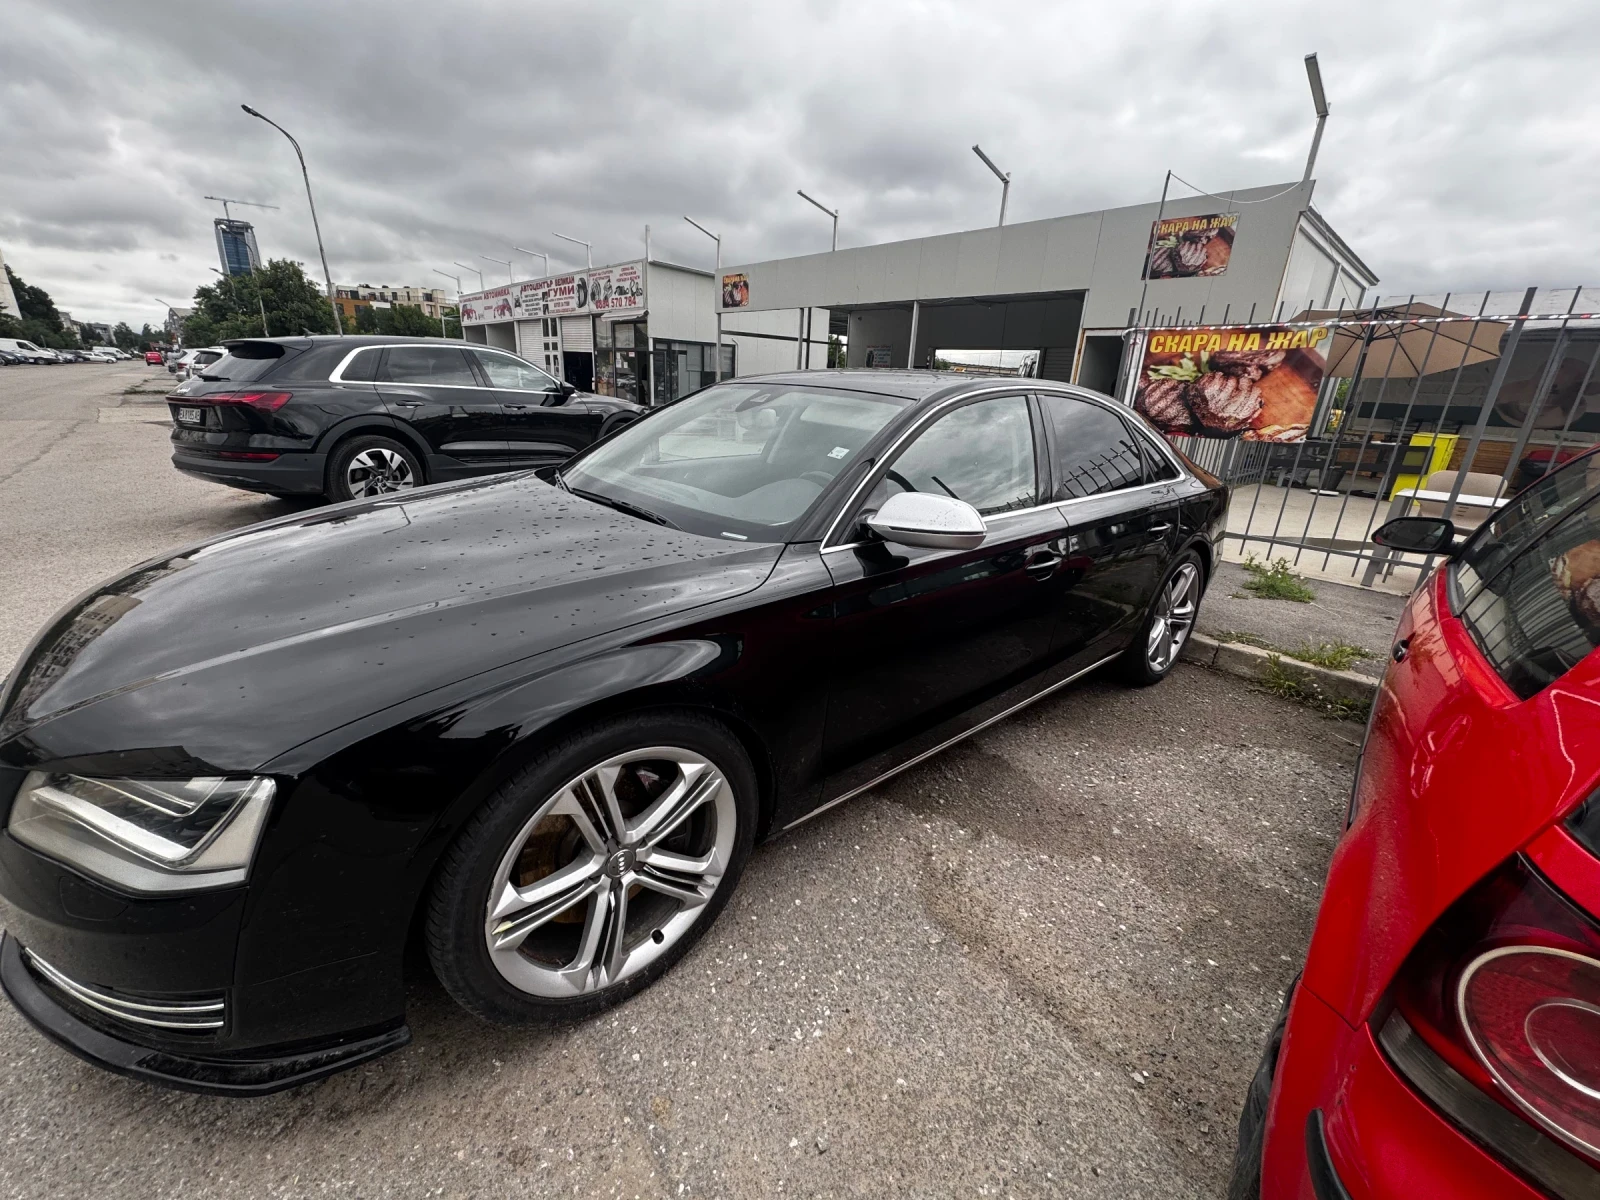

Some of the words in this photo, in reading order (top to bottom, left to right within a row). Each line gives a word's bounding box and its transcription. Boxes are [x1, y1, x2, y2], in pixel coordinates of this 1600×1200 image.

[1192, 219, 1207, 231] НА
[1209, 216, 1237, 228] ЖАР
[520, 280, 553, 292] АВТОЦЕНТЪР
[546, 285, 575, 298] ГУМИ
[611, 297, 623, 307] 570
[1149, 334, 1221, 353] СКАРА
[1226, 333, 1260, 352] НА
[1265, 327, 1328, 350] ЖАР
